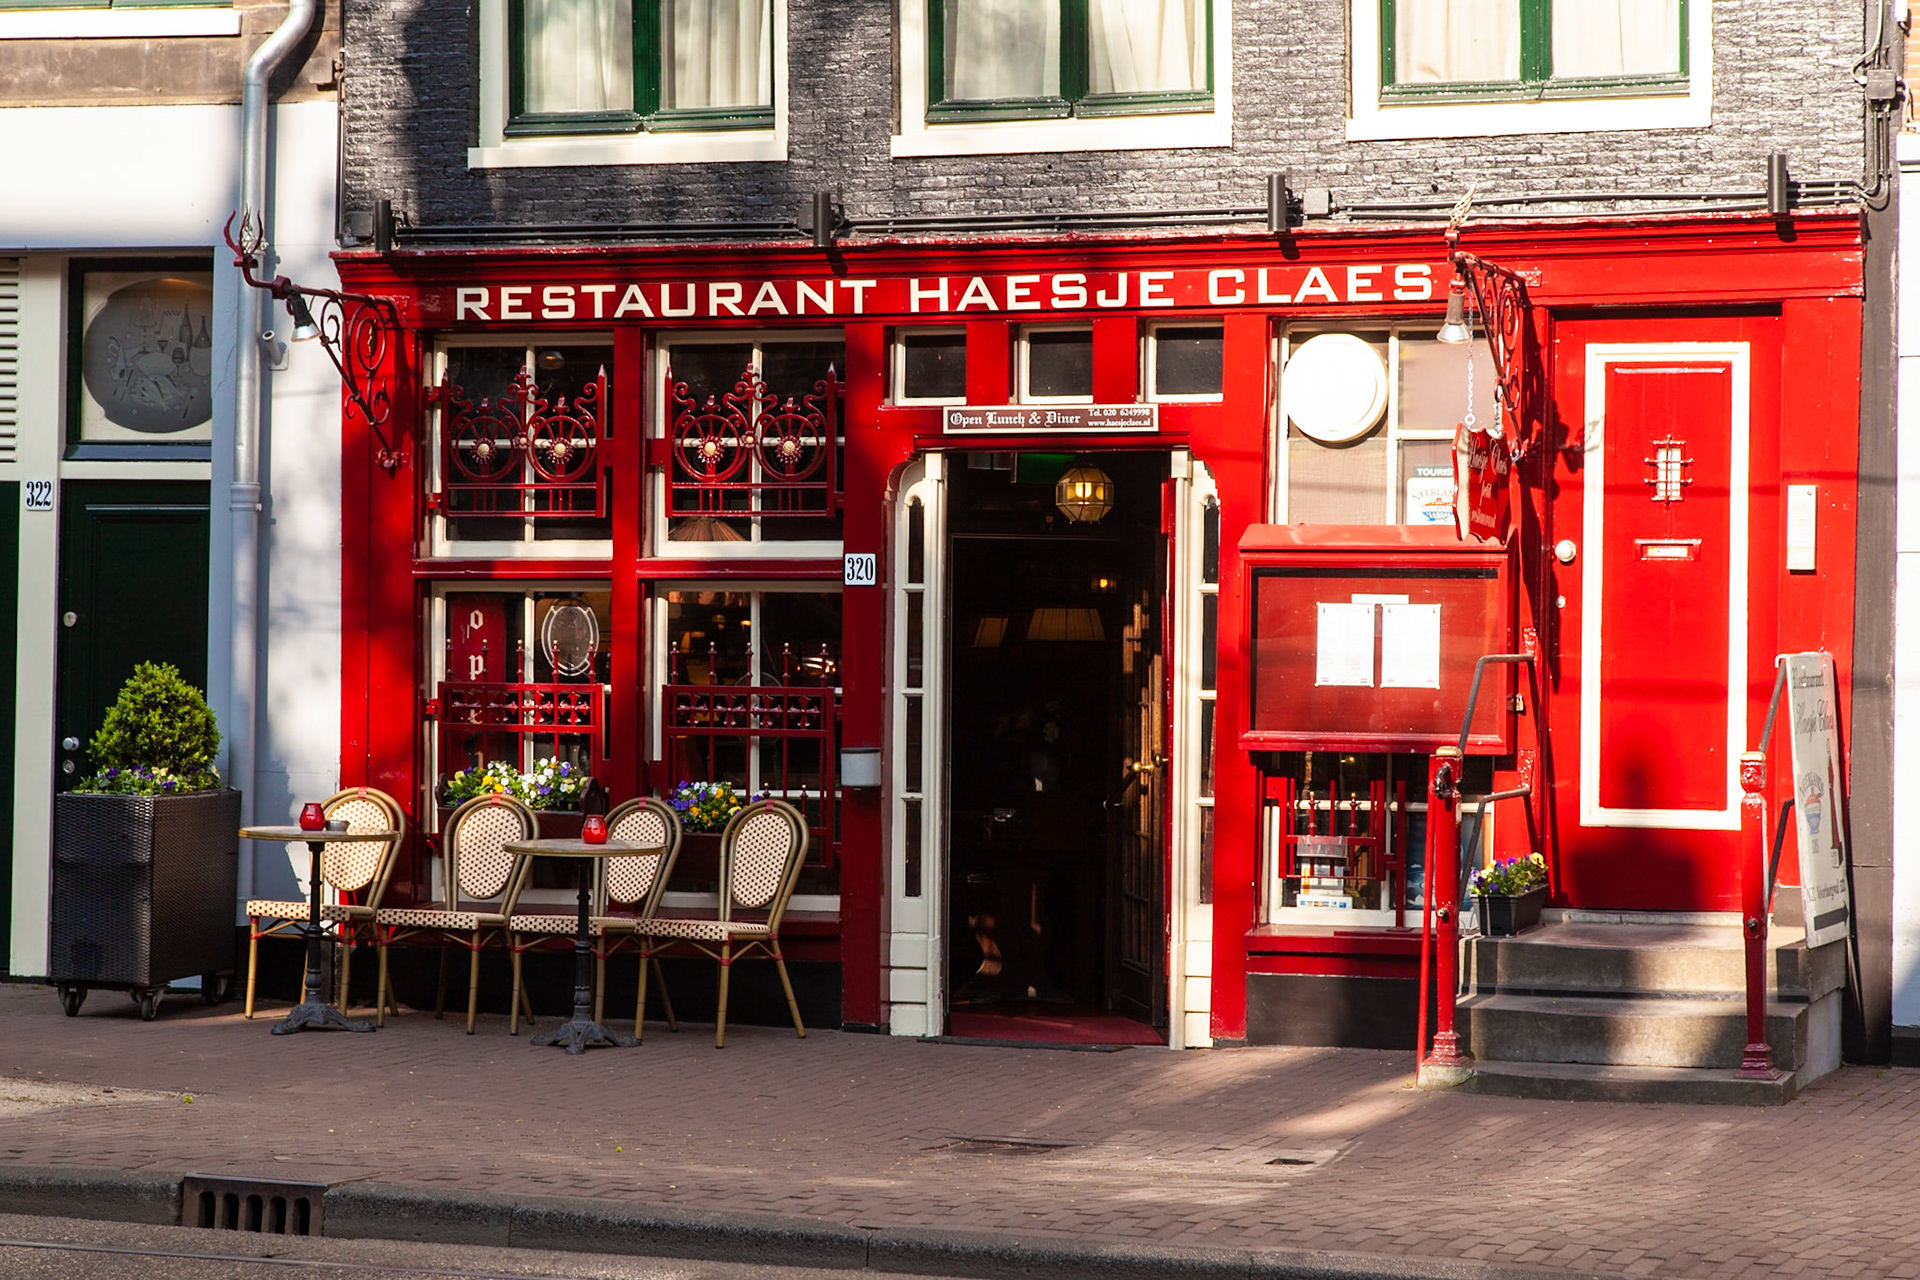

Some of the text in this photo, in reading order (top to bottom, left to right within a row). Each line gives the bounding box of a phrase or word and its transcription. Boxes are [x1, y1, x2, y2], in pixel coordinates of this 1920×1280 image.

[457, 264, 1432, 320] RESTAURANT HAESJE CLAES
[950, 410, 1081, 428] Open Lunch & Diner
[1103, 408, 1117, 417] 020
[1119, 407, 1151, 416] 6249998
[1087, 418, 1151, 428] www.haesjeclaes.nl
[1416, 467, 1454, 477] TOURIS
[26, 480, 52, 507] 322
[846, 557, 874, 581] 320
